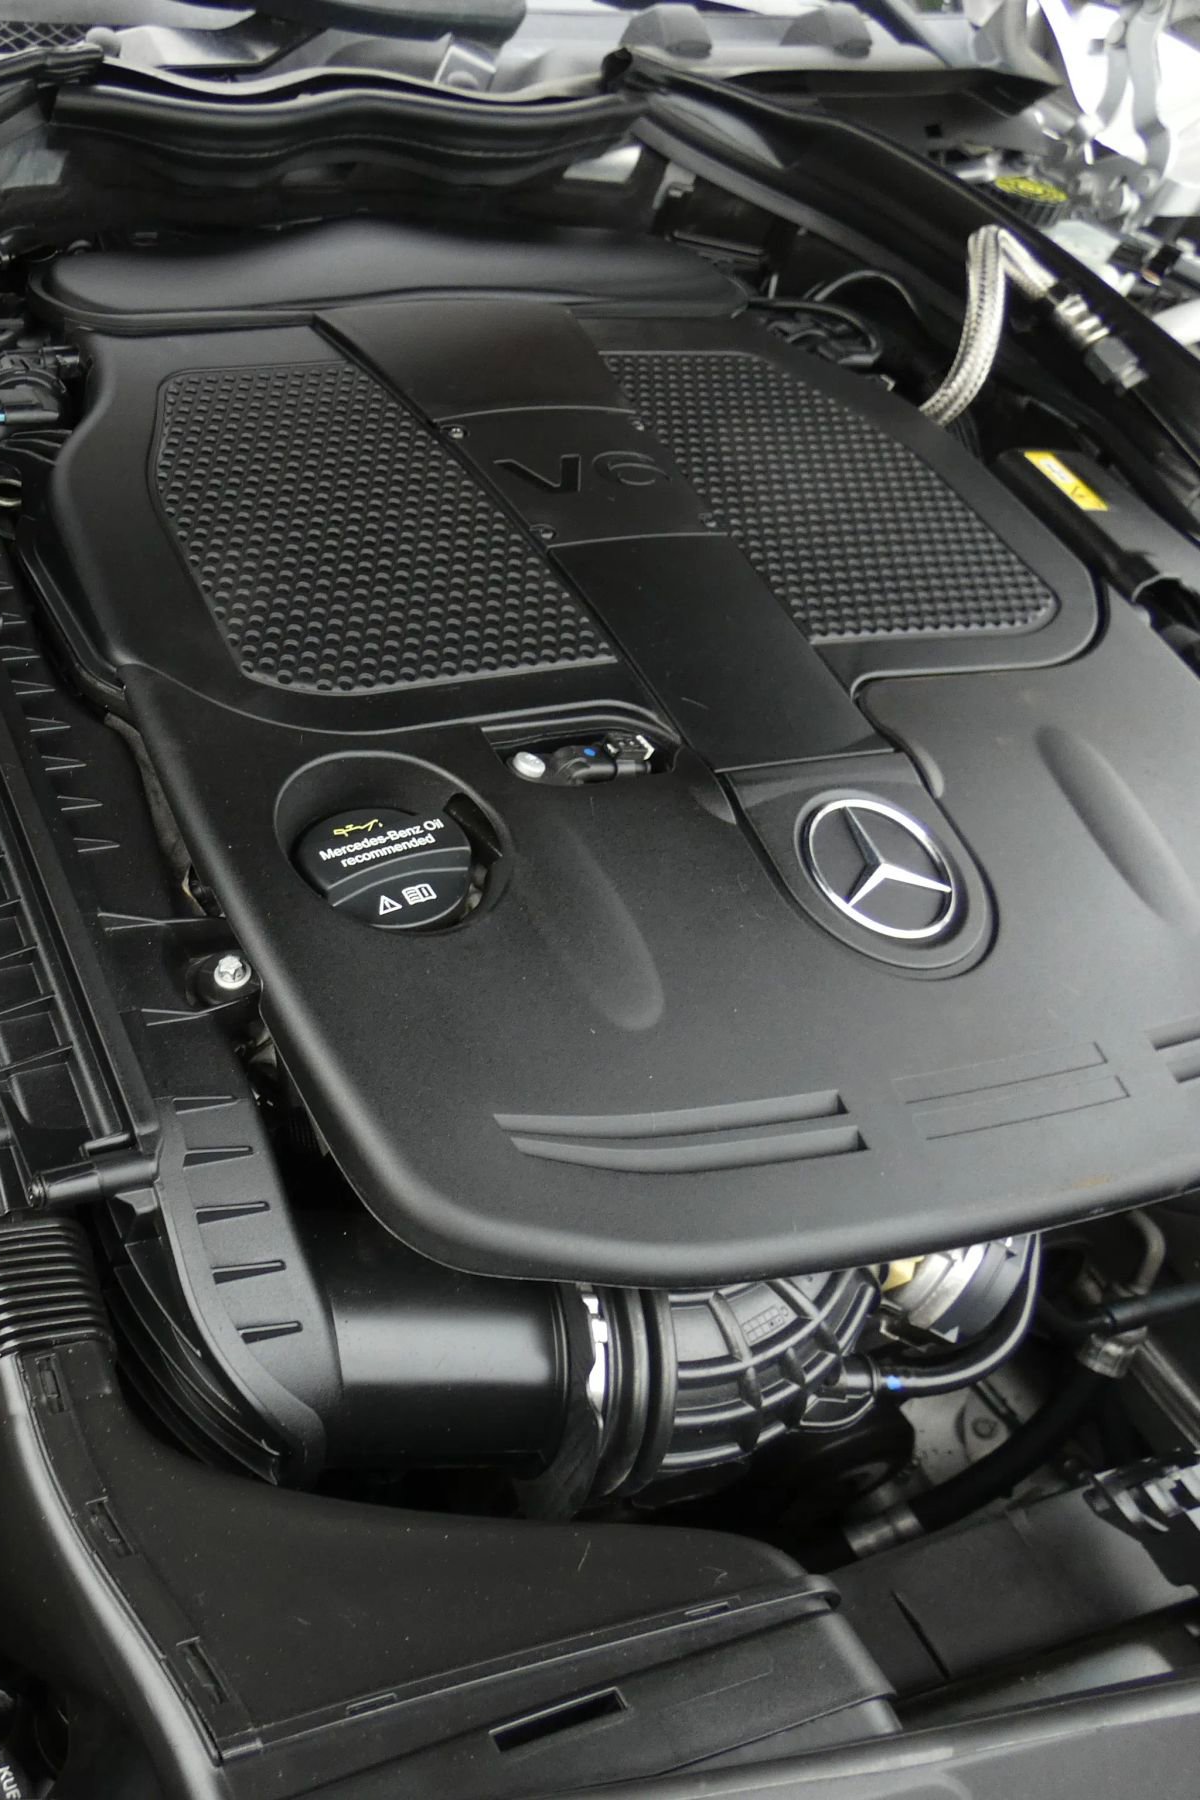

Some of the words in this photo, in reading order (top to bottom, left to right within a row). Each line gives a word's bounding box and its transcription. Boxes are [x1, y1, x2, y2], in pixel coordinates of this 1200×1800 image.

[319, 825, 424, 861] Mercedes-Benz
[423, 818, 444, 832] Oil
[341, 833, 436, 868] recommended
